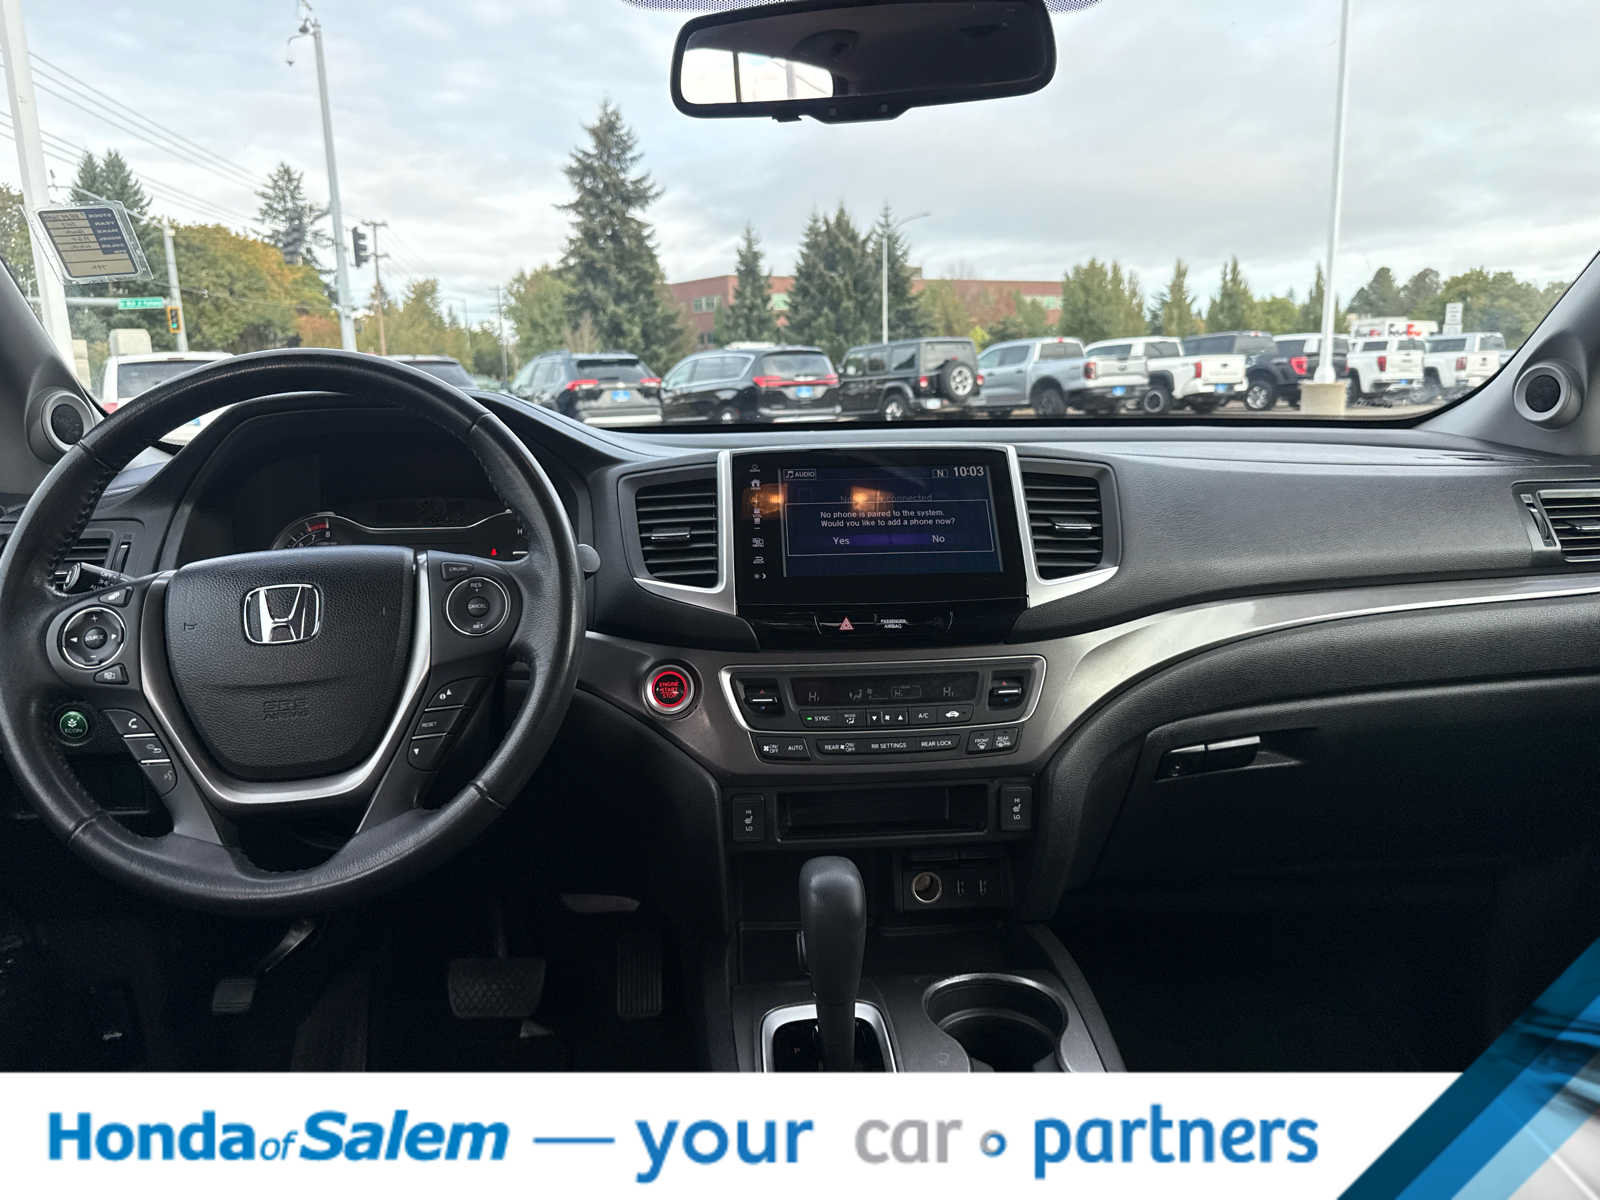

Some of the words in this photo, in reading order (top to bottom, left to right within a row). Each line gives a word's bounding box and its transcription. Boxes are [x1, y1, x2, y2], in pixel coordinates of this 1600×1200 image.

[953, 466, 985, 477] 10:03
[833, 511, 857, 519] phone
[867, 510, 891, 518] paired
[916, 509, 945, 518] system.
[821, 519, 844, 527] Would
[846, 520, 860, 528] you
[887, 518, 902, 526] add
[909, 518, 933, 526] phone
[935, 517, 956, 525] now?
[832, 536, 850, 545] Yes
[932, 535, 945, 543] No
[880, 741, 907, 749] SETTINGS
